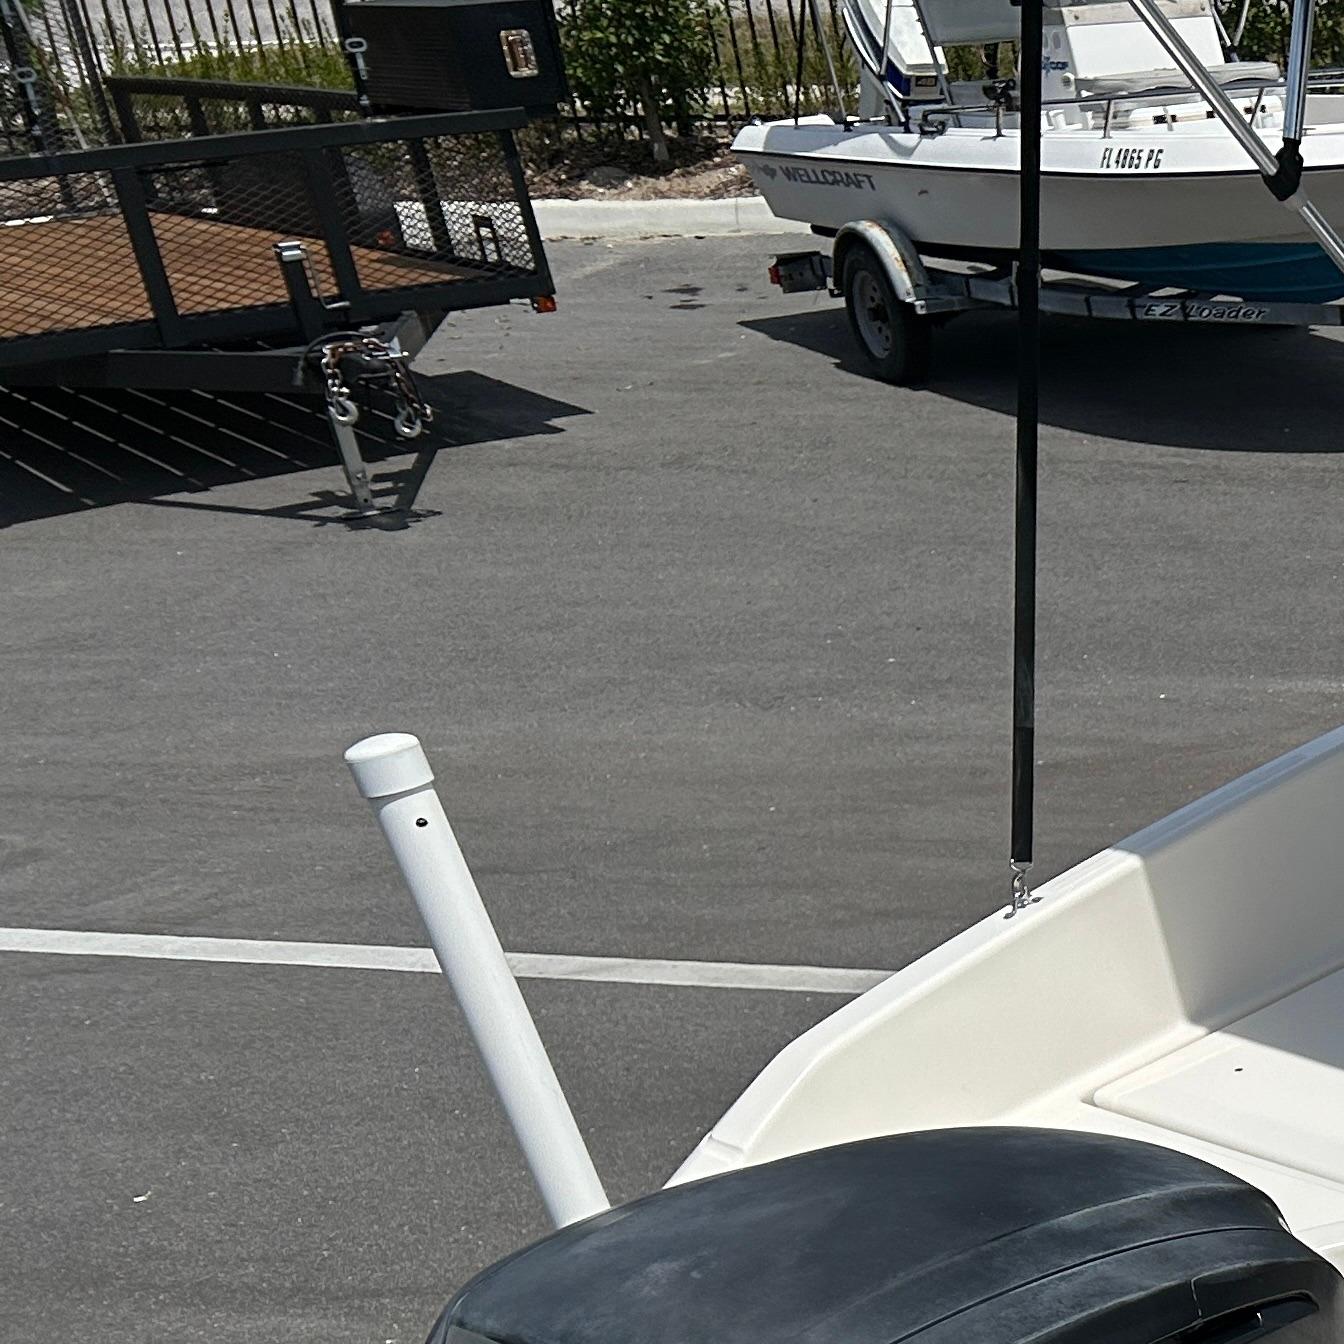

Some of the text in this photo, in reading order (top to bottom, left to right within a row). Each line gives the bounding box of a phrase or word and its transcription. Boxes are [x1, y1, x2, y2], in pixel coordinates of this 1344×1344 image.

[1100, 147, 1113, 169] FL
[1144, 148, 1164, 169] PG
[779, 165, 876, 192] WELLCRAFT
[1143, 302, 1268, 320] EZ Loader
